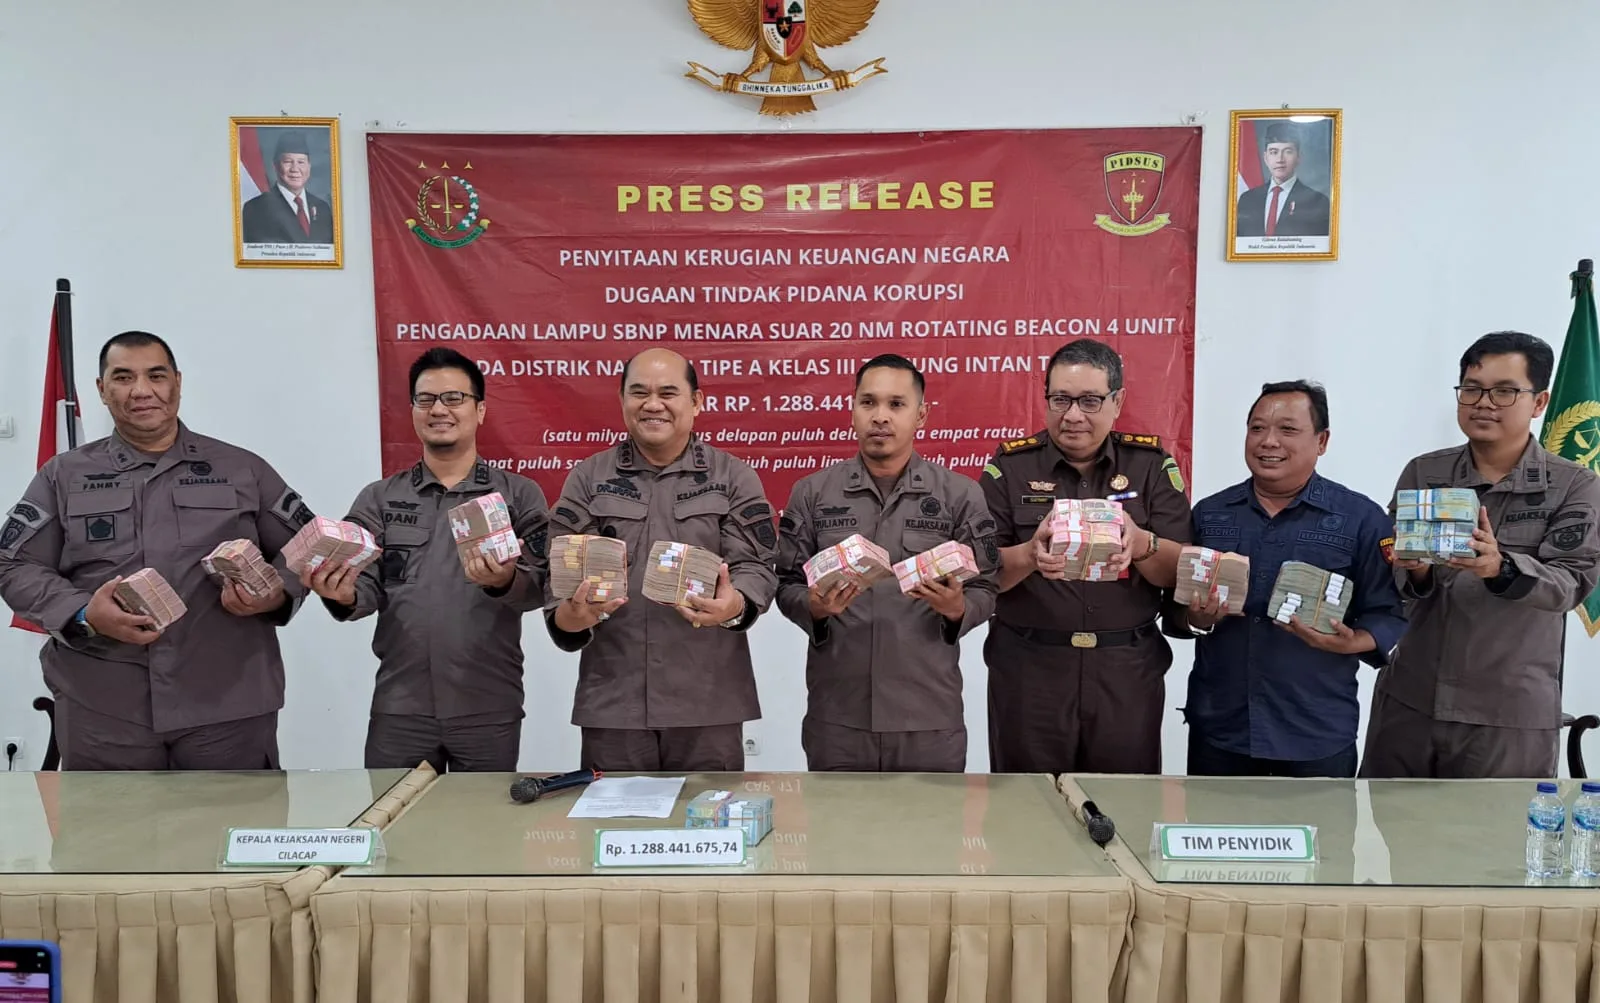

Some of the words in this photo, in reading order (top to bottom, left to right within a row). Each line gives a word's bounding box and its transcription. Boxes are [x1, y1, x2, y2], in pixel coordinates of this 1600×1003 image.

[1110, 156, 1159, 169] PIDSUS
[617, 184, 764, 212] PRESS
[787, 181, 994, 210] RELEASE
[560, 249, 677, 266] PENYITAAN
[685, 248, 791, 266] KERUGIAN
[800, 247, 916, 264] KEUANGAN
[924, 246, 1009, 263] NEGARA
[606, 286, 695, 303] DUGAAN
[703, 286, 780, 302] TINDAK
[788, 286, 866, 302] PIDANA
[874, 284, 963, 301] KORUPSI
[397, 323, 526, 340] PENGADAAN
[534, 323, 606, 340] LAMPU
[614, 323, 667, 340] SBNP
[675, 322, 762, 340] MENARA
[770, 322, 822, 339] SUAR
[831, 322, 851, 338] 20
[859, 322, 893, 338] NM
[902, 320, 1007, 337] ROTATING
[1015, 319, 1100, 335] BEACON
[1107, 318, 1119, 335] 4
[1126, 317, 1176, 335] UNIT
[512, 359, 589, 376] DISTRIK
[702, 359, 742, 375] TIPE
[749, 359, 762, 375] A
[769, 359, 830, 375] KELAS
[837, 359, 855, 375] III
[966, 356, 1031, 373] INTAN
[725, 396, 756, 412] RP.
[543, 429, 581, 444] (satu
[586, 428, 628, 445] milya
[716, 428, 776, 445] delapan
[781, 428, 824, 445] puluh
[930, 427, 980, 443] empat
[984, 427, 1025, 439] ratus
[517, 456, 561, 472] puluh
[773, 456, 820, 473] puluh
[82, 481, 121, 491] FAHMY
[385, 512, 418, 525] DANI
[236, 835, 271, 844] KEPALA
[274, 835, 327, 844] KEJAKSAAN
[331, 835, 365, 844] NEGERI
[1181, 836, 1212, 850] TIM
[1218, 837, 1292, 851] PENYIDIK
[278, 851, 317, 860] CILACAP
[606, 844, 625, 857] Rp.
[630, 842, 737, 855] 1.288.441.675,74
